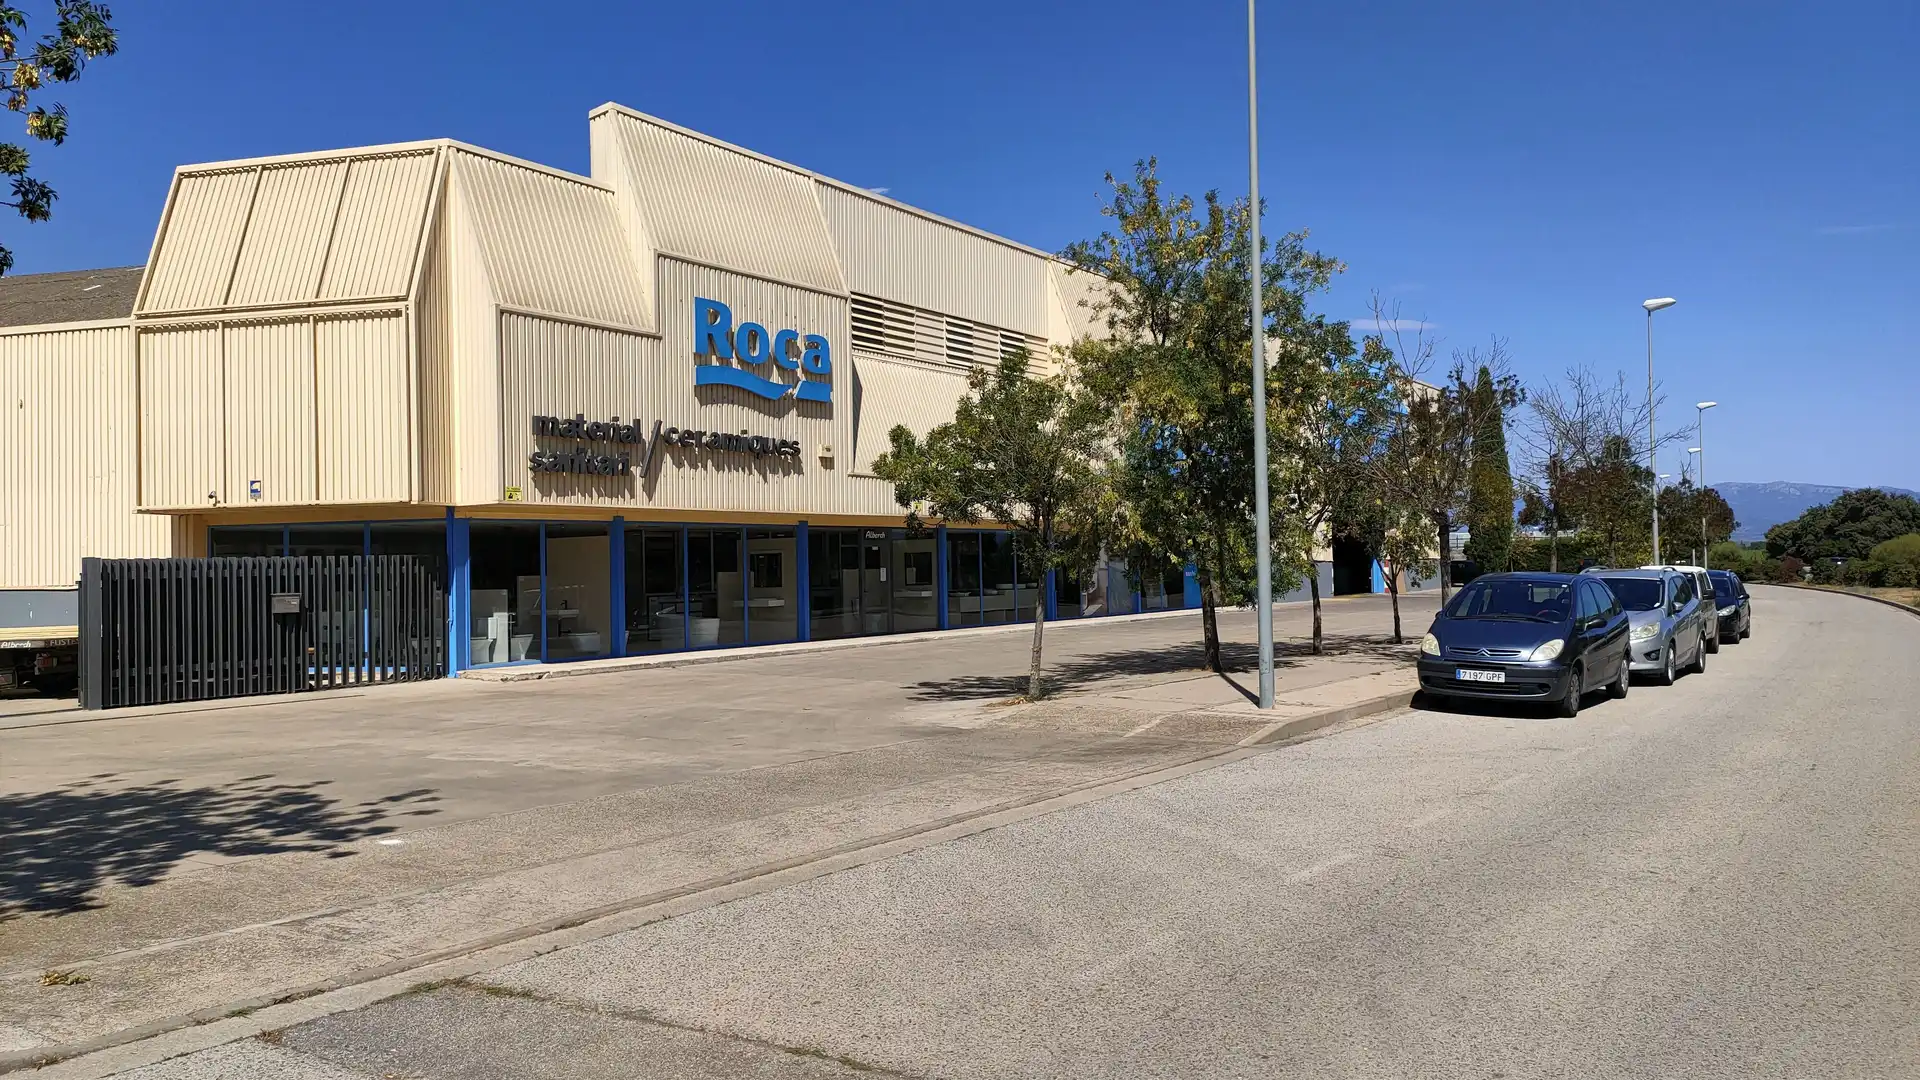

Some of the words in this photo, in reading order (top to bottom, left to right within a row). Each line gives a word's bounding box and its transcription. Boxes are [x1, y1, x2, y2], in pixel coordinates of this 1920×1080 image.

[694, 296, 832, 375] Roca
[532, 413, 641, 444] material
[663, 426, 801, 459] ceramiques
[529, 447, 630, 476] sanitari
[1462, 671, 1484, 680] 7197
[1486, 672, 1503, 682] GPF
